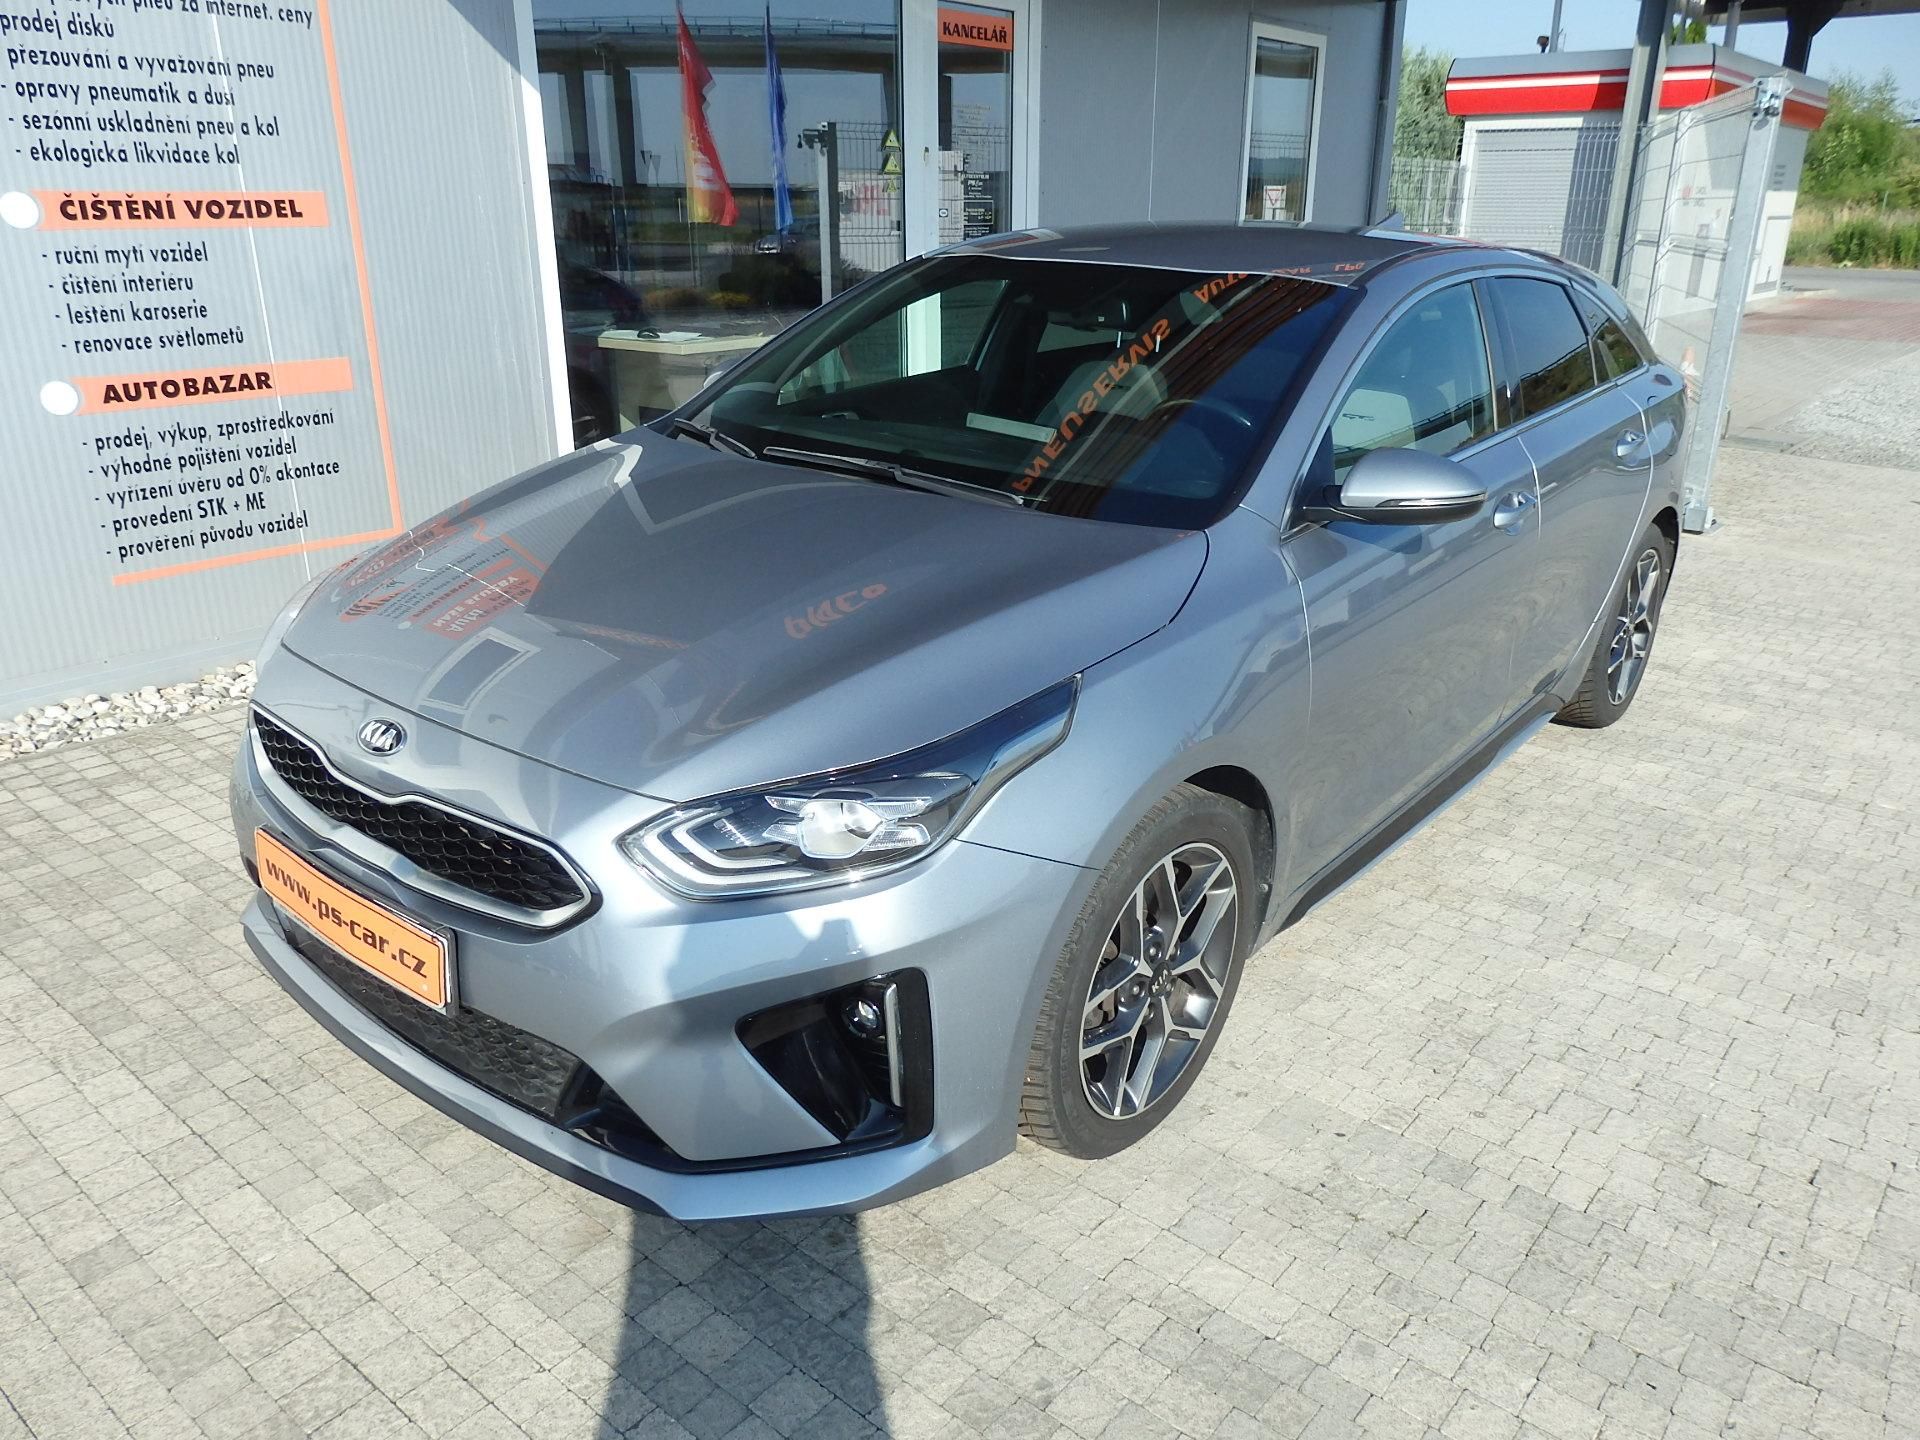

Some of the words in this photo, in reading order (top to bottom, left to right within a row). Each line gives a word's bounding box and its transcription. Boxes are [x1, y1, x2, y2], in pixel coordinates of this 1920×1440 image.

[0, 8, 63, 40] prodej
[67, 11, 115, 38] disků
[206, 0, 273, 20] internet.
[278, 7, 312, 29] ceny
[942, 21, 1008, 43] KANCELÁŘ
[7, 44, 111, 70] přezouvání
[118, 55, 129, 70] a
[134, 54, 232, 78] vyvažování
[236, 62, 275, 82] pneu
[15, 81, 80, 105] opravy
[88, 81, 182, 106] pneumatik
[187, 90, 198, 104] a
[22, 109, 91, 131] sezónní
[97, 109, 191, 134] uskladnění
[196, 119, 235, 140] pneu
[241, 122, 250, 136] a
[254, 115, 280, 136] kol
[30, 138, 129, 168] ekologická
[133, 141, 210, 164] likvidace
[214, 142, 240, 164] kol
[59, 193, 176, 221] ČIŠTĚNÍ
[183, 199, 304, 220] VOZIDEL
[55, 244, 99, 265] ruční
[105, 243, 145, 269] mytí
[149, 241, 209, 263] vozidel
[62, 273, 118, 295] čištění
[121, 270, 194, 293] interiéru
[66, 302, 126, 325] leštění
[129, 298, 208, 322] karoserie
[74, 333, 153, 354] renovace
[159, 325, 244, 349] světlometů
[102, 370, 274, 404] AUTOBAZAR
[94, 425, 152, 456] prodej,
[157, 421, 212, 448] výkup,
[216, 407, 335, 438] zprostředkování
[100, 452, 172, 482] výhodné
[178, 444, 241, 472] pojištění
[246, 436, 297, 460] vozidel
[106, 479, 173, 509] vyřízení
[178, 475, 221, 497] úvěru
[226, 467, 245, 489] od
[249, 464, 271, 485] 0%
[276, 459, 340, 482] akontace
[112, 504, 193, 537] provedení
[197, 497, 228, 519] STK
[233, 500, 241, 511] +
[246, 491, 266, 513] ME
[118, 529, 195, 563] prověření
[199, 519, 253, 548] původu
[258, 509, 309, 535] vozidel
[265, 857, 428, 979] www.ps-car.cz
